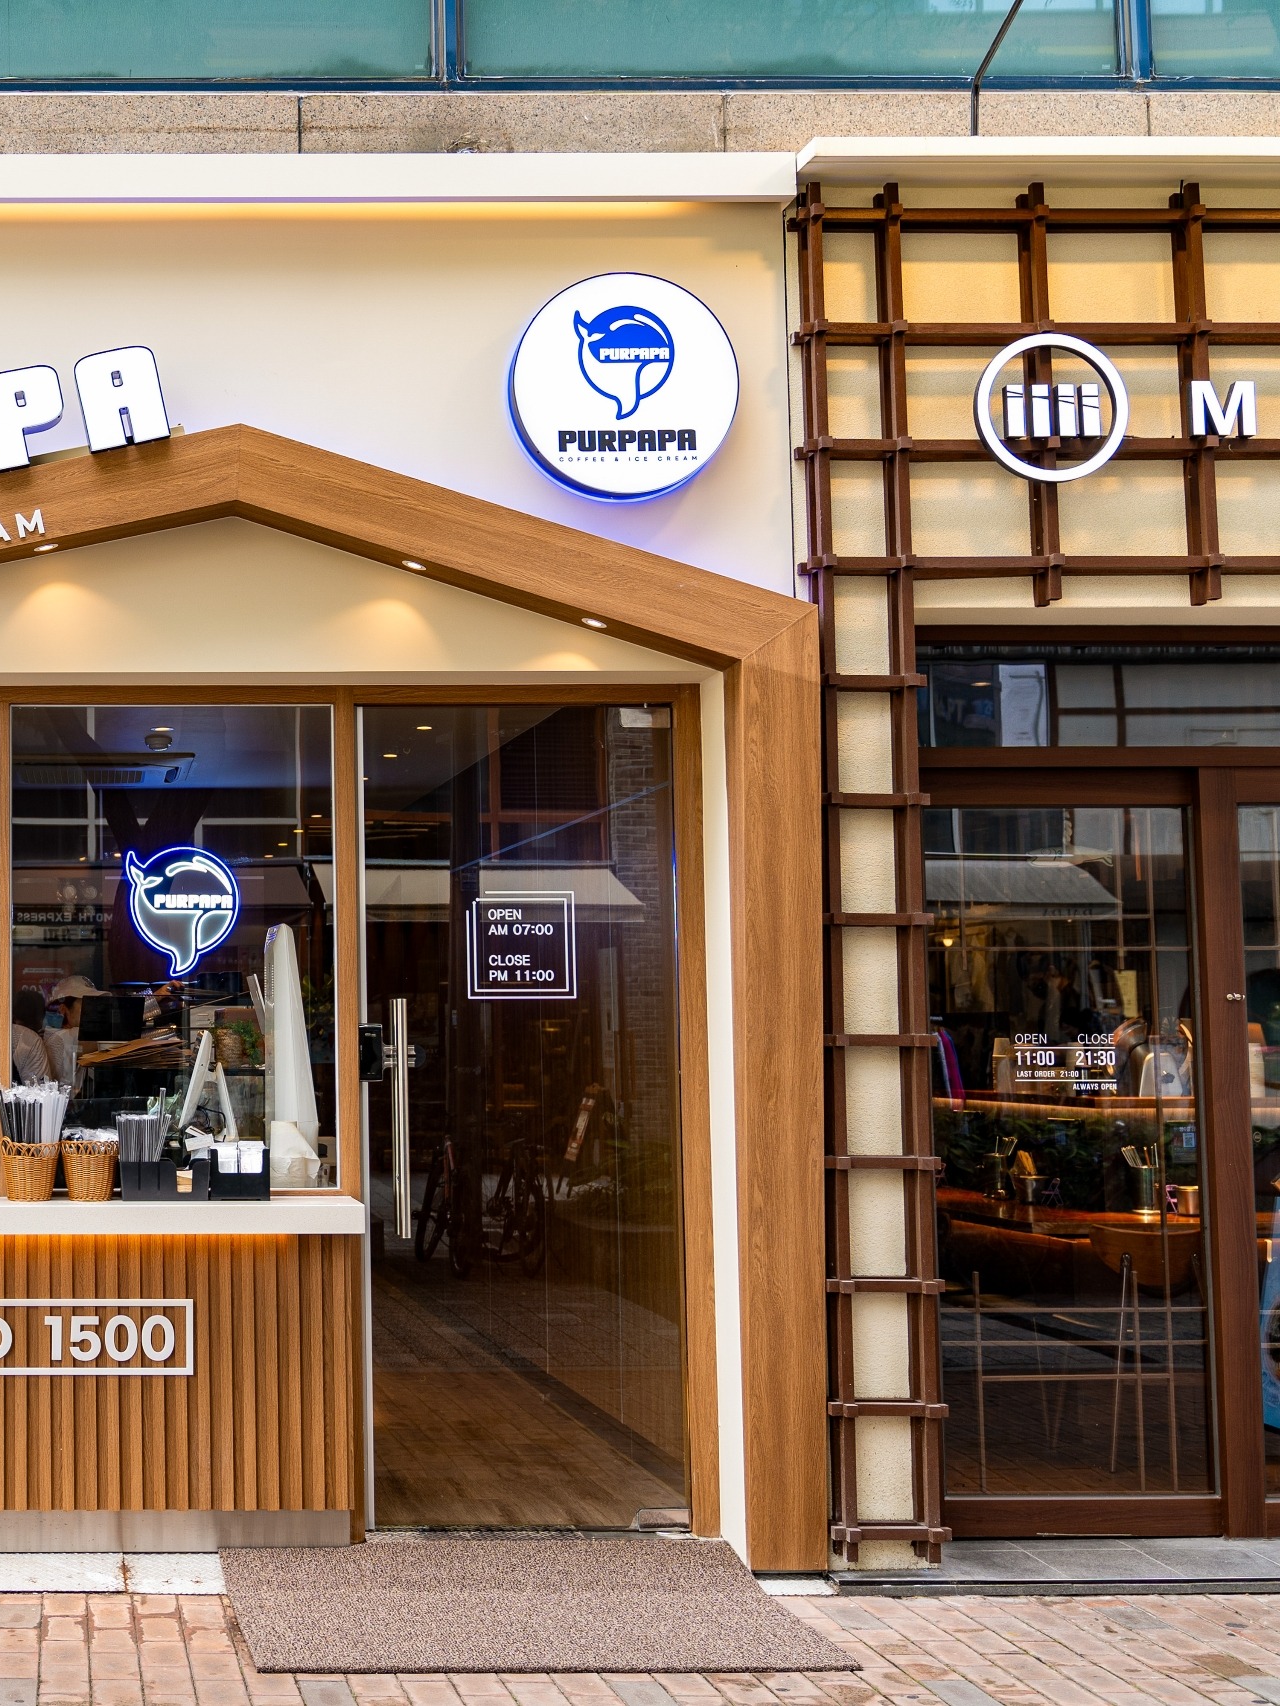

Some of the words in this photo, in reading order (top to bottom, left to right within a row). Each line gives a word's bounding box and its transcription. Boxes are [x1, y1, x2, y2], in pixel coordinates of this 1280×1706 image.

[599, 347, 670, 360] PURPAPA
[558, 429, 697, 452] PURPAPA
[154, 894, 233, 909] PURPAPA
[488, 909, 522, 920] OPEN
[488, 924, 508, 935] AM
[512, 924, 554, 936] 07:00
[488, 955, 531, 966] CLOSE
[489, 970, 508, 981] PM
[515, 970, 555, 981] 11:00
[1014, 1033, 1047, 1044] OPEN
[1077, 1033, 1115, 1044] CLOSE
[1015, 1050, 1055, 1066] 11:00
[1075, 1050, 1116, 1066] 21:30
[1016, 1070, 1032, 1078] LAST
[1034, 1070, 1056, 1078] ORDER
[1059, 1070, 1079, 1078] 21:00
[1072, 1083, 1099, 1091] ALWAYS
[1100, 1083, 1117, 1091] OPEN
[44, 1315, 176, 1362] 1500
